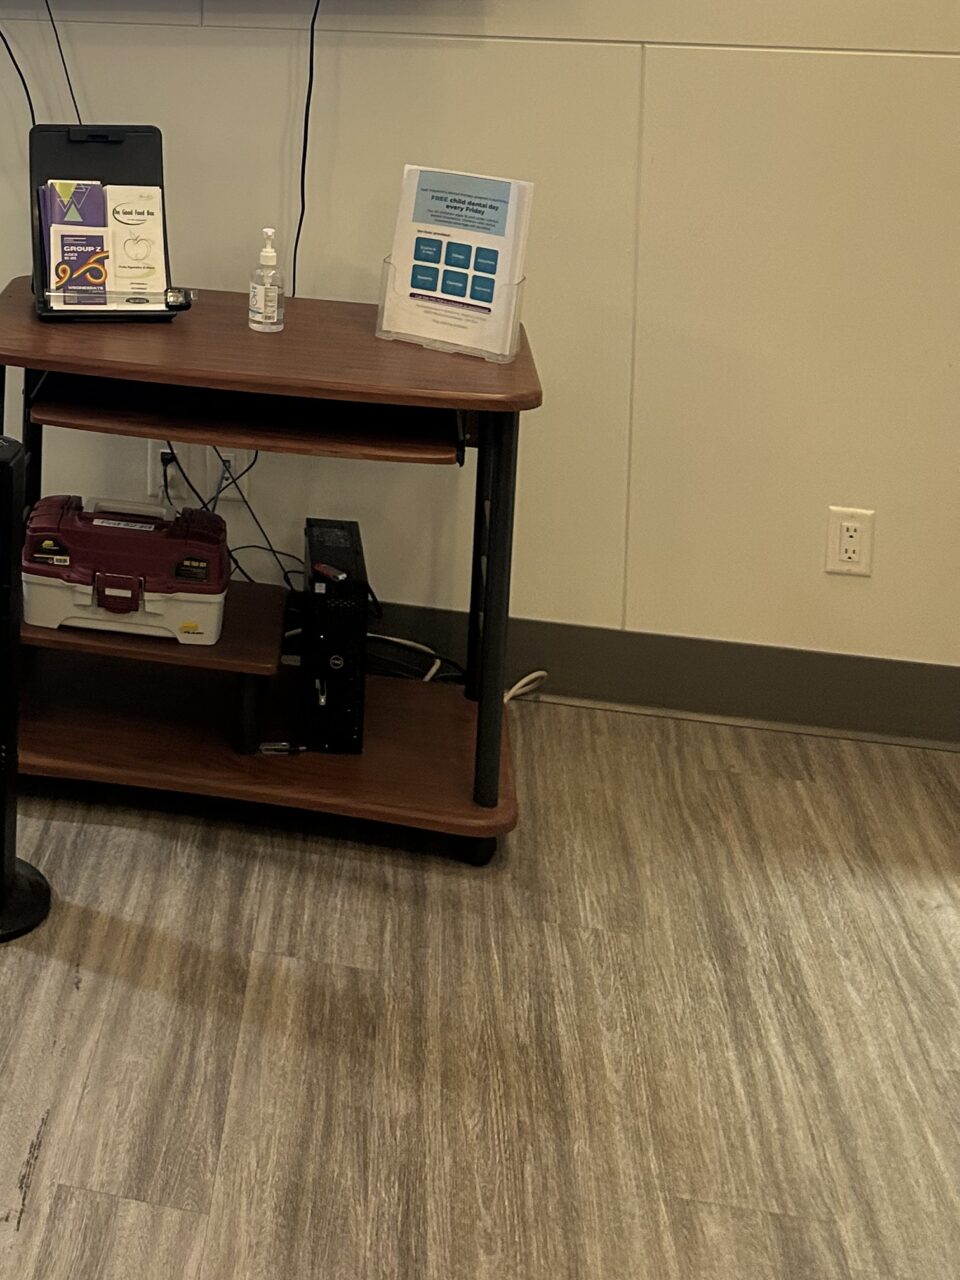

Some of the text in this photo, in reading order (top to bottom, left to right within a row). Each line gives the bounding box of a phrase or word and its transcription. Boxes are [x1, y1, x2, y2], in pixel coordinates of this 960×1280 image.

[467, 200, 487, 208] dental
[446, 204, 485, 215] every Friday
